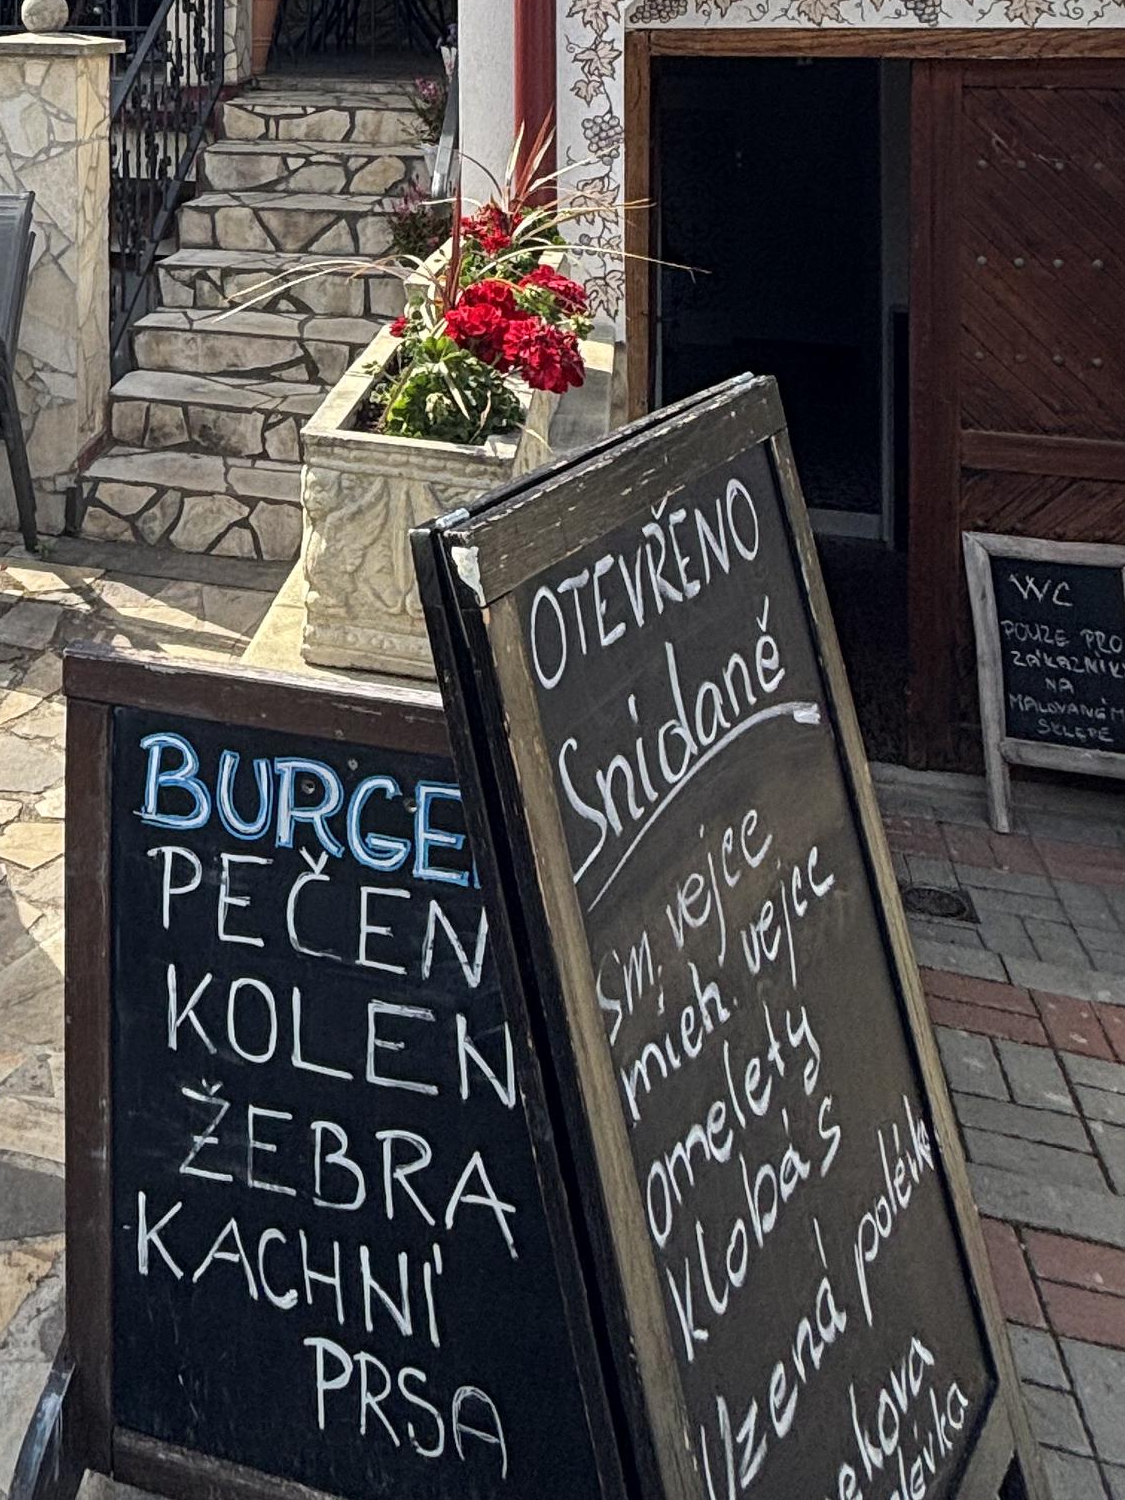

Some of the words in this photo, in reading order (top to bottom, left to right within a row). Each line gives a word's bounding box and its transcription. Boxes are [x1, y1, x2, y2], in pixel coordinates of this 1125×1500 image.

[530, 478, 759, 690] OTEVŘENO
[1000, 620, 1070, 647] POUZE
[1080, 629, 1123, 653] PRO
[1007, 573, 1073, 607] WC
[1044, 677, 1074, 694] NA
[134, 732, 482, 890] BURGE
[147, 847, 489, 989] PEČEN
[666, 810, 773, 967] vejce
[166, 964, 517, 1109] KOLEN
[178, 1080, 519, 1259] ŽEBRA
[647, 1001, 820, 1250] omelety
[135, 1190, 443, 1348] KACHNÍ
[303, 1337, 509, 1480] PRSA
[889, 1382, 969, 1500] lévka
